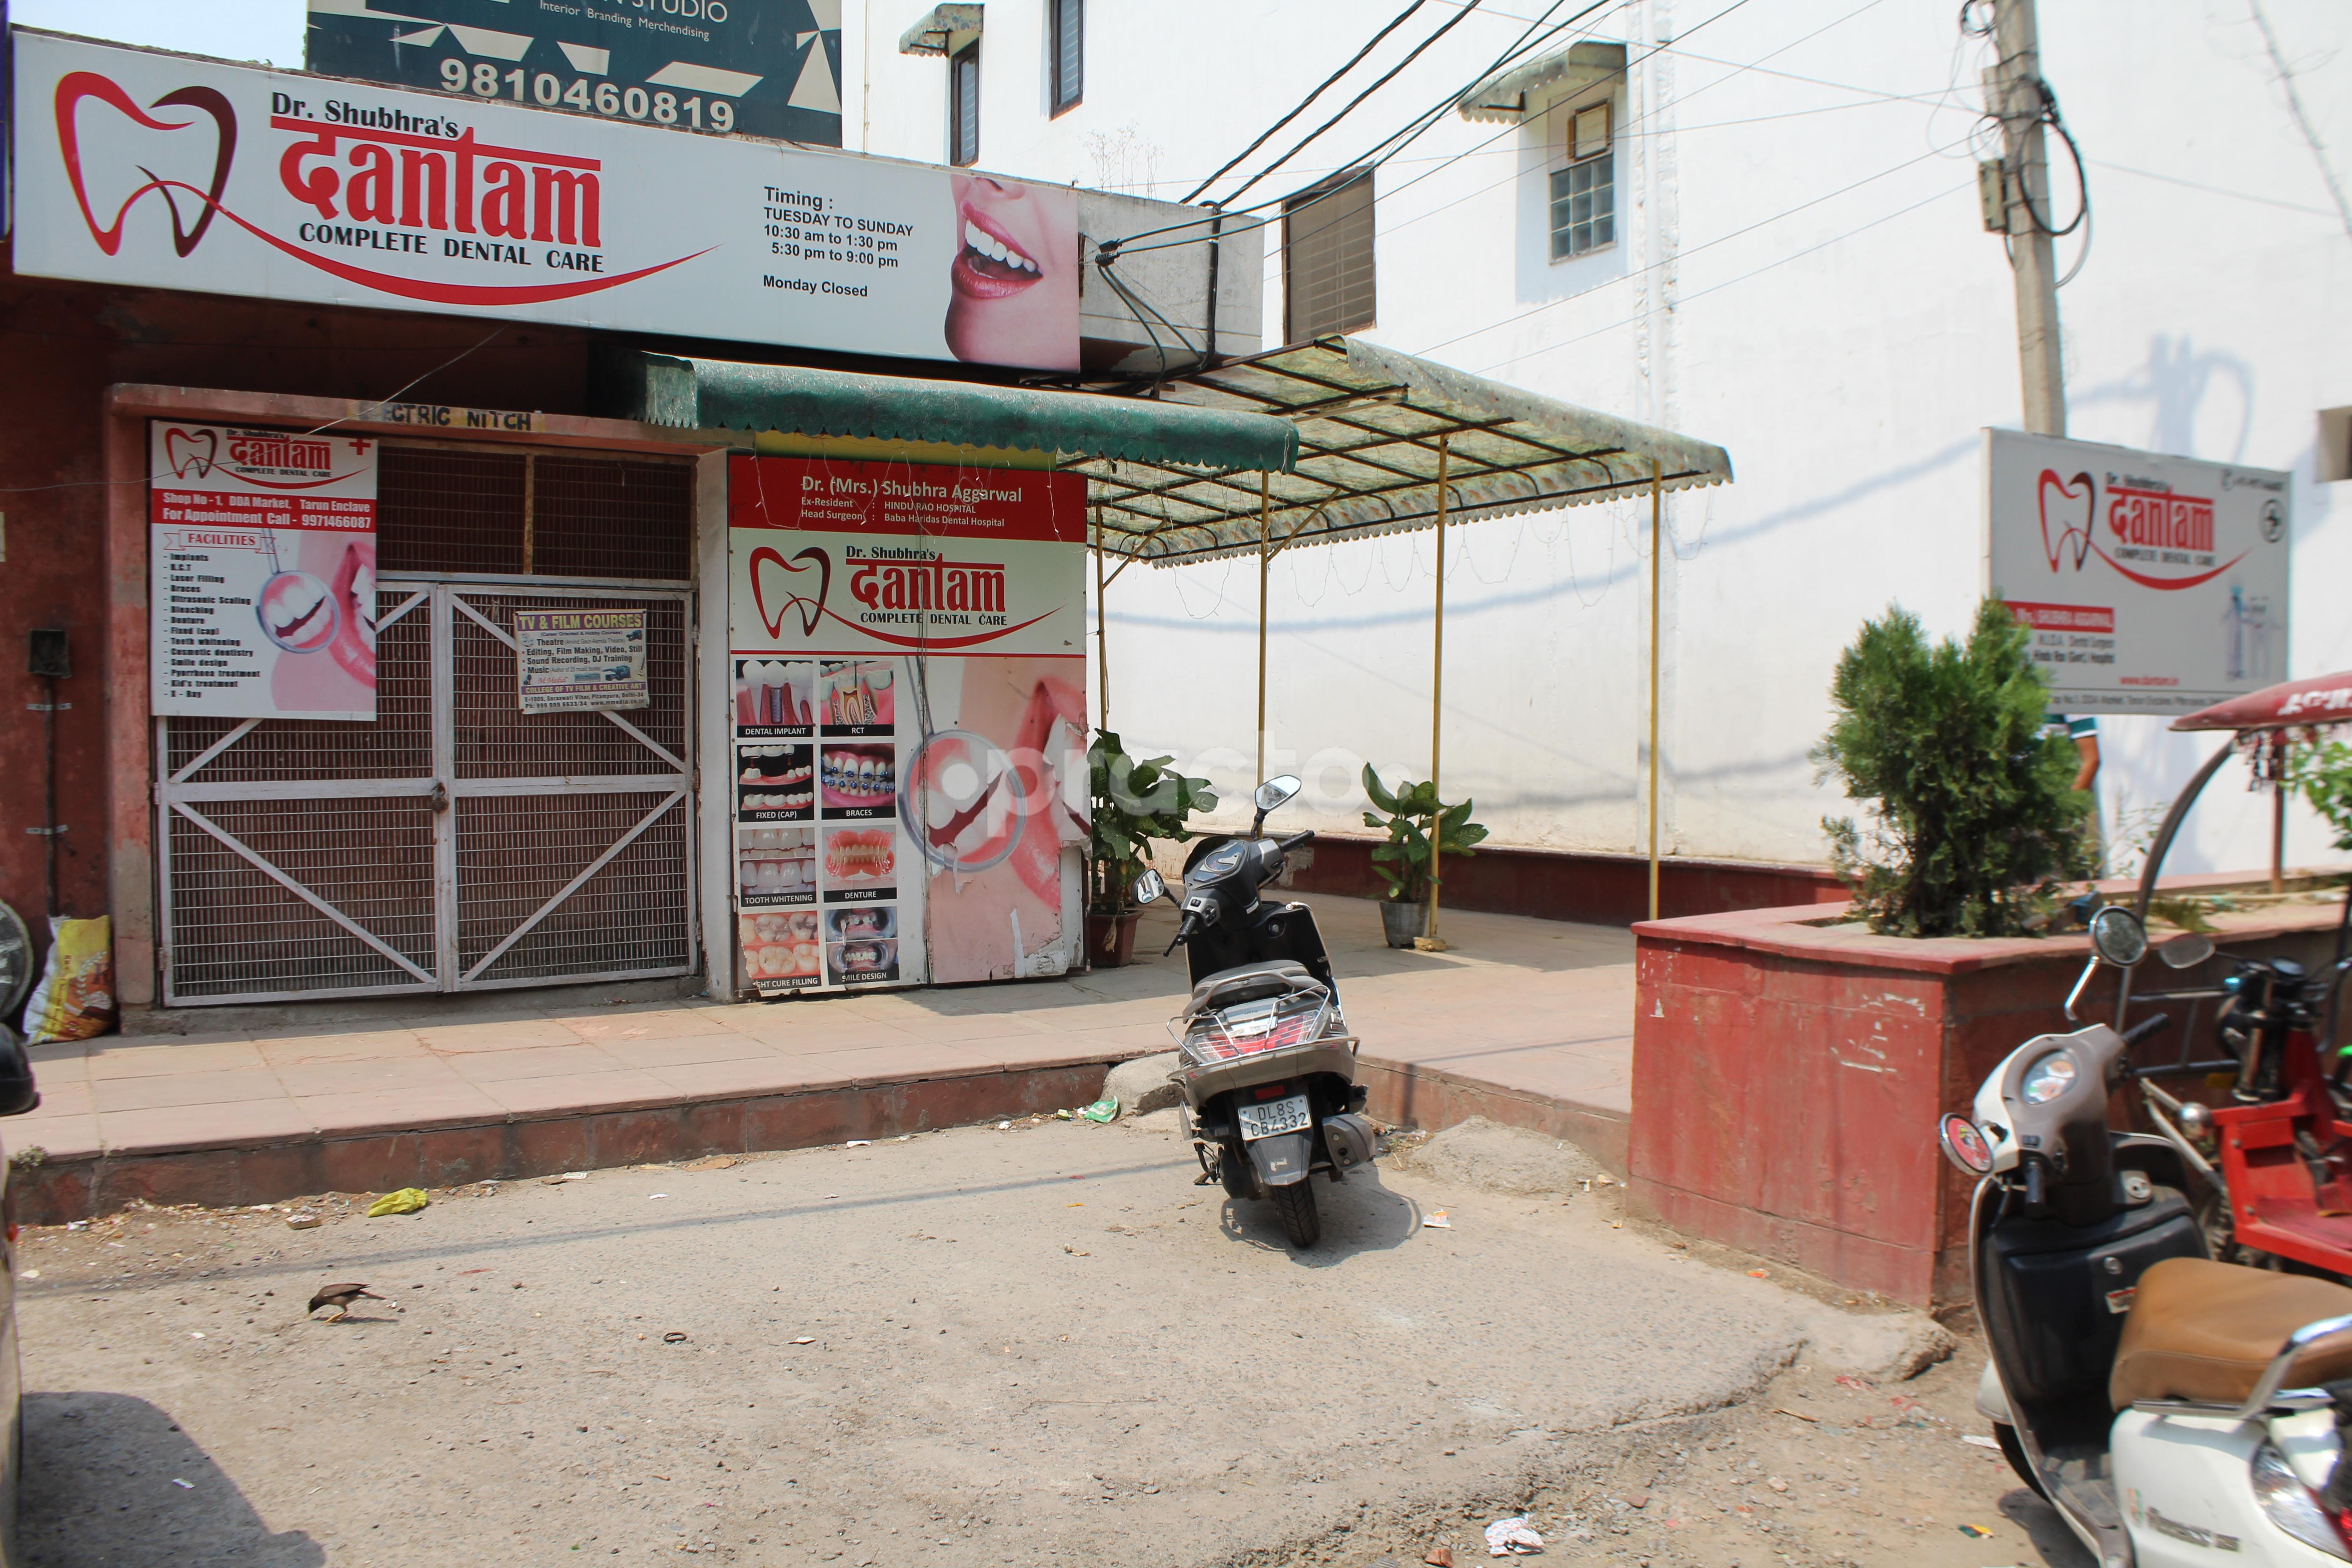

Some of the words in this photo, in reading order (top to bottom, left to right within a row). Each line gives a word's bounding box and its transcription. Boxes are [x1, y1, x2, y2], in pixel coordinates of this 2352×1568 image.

[540, 0, 580, 16] Interior
[588, 8, 632, 28] Branding
[639, 17, 709, 42] Merchendising
[440, 59, 734, 132] 9810460819
[273, 92, 314, 118] Dr.
[325, 100, 459, 137] Shubhra's
[764, 186, 823, 211] Timing
[764, 207, 830, 226] TUESDAY
[834, 216, 853, 229] TO
[858, 219, 913, 236] SUNDAY
[300, 223, 427, 254] COMPLETE
[444, 239, 531, 265] DENTAL
[547, 250, 603, 272] CARE
[764, 225, 800, 239] 10:30
[804, 232, 824, 242] am
[829, 233, 842, 244] to
[846, 235, 873, 248] 1:30
[877, 240, 897, 251] pm
[772, 242, 799, 256] 5:30
[804, 248, 825, 260] pm
[829, 250, 842, 261] to
[847, 251, 873, 264] 9:00
[878, 256, 898, 268] pm
[763, 275, 817, 294] Monday
[822, 282, 867, 297] Closed
[802, 476, 824, 491] Dr.
[830, 477, 878, 497] (Mrs.)
[882, 480, 947, 498] Shubhra
[951, 485, 1021, 503] Aggarwal
[163, 492, 191, 505] Shop
[193, 494, 207, 505] No
[229, 496, 250, 507] DDA
[252, 497, 292, 509] Market,
[299, 499, 329, 510] Tarun
[331, 501, 370, 512] Enclave
[801, 497, 853, 508] Ex-Resident
[884, 501, 913, 510] HINDU
[916, 503, 934, 511] RAO
[936, 504, 976, 514] HOSPITAL
[163, 508, 182, 520] For
[185, 509, 263, 524] Appointment
[267, 513, 290, 525] Call
[302, 514, 371, 529] 9971466087
[801, 510, 824, 518] Head
[827, 510, 862, 521] Surgeon
[884, 513, 906, 522] Baba
[909, 514, 940, 523] Haridas
[942, 516, 968, 525] Dental
[971, 518, 1004, 528] Hospital
[188, 533, 256, 545] FACILITIES
[846, 545, 866, 558] Dr.
[871, 547, 936, 560] Shubhra's
[519, 616, 535, 630] TV
[539, 616, 549, 629] &
[552, 615, 580, 629] FILM
[584, 614, 642, 628] COURSES
[861, 612, 923, 624] COMPLETE
[930, 614, 971, 625] DENTAL
[979, 615, 1007, 626] CARE
[527, 648, 554, 657] Editing,
[552, 656, 590, 664] Recording,
[604, 655, 632, 663] Training
[745, 896, 769, 904] TOOTH
[771, 894, 813, 903] WHITENING
[845, 891, 877, 899] DENTURE
[757, 980, 770, 989] GHT
[772, 979, 790, 987] CURE
[792, 977, 818, 986] FILLING
[1258, 1101, 1294, 1120] DL8S
[1251, 1112, 1308, 1136] CB4332
